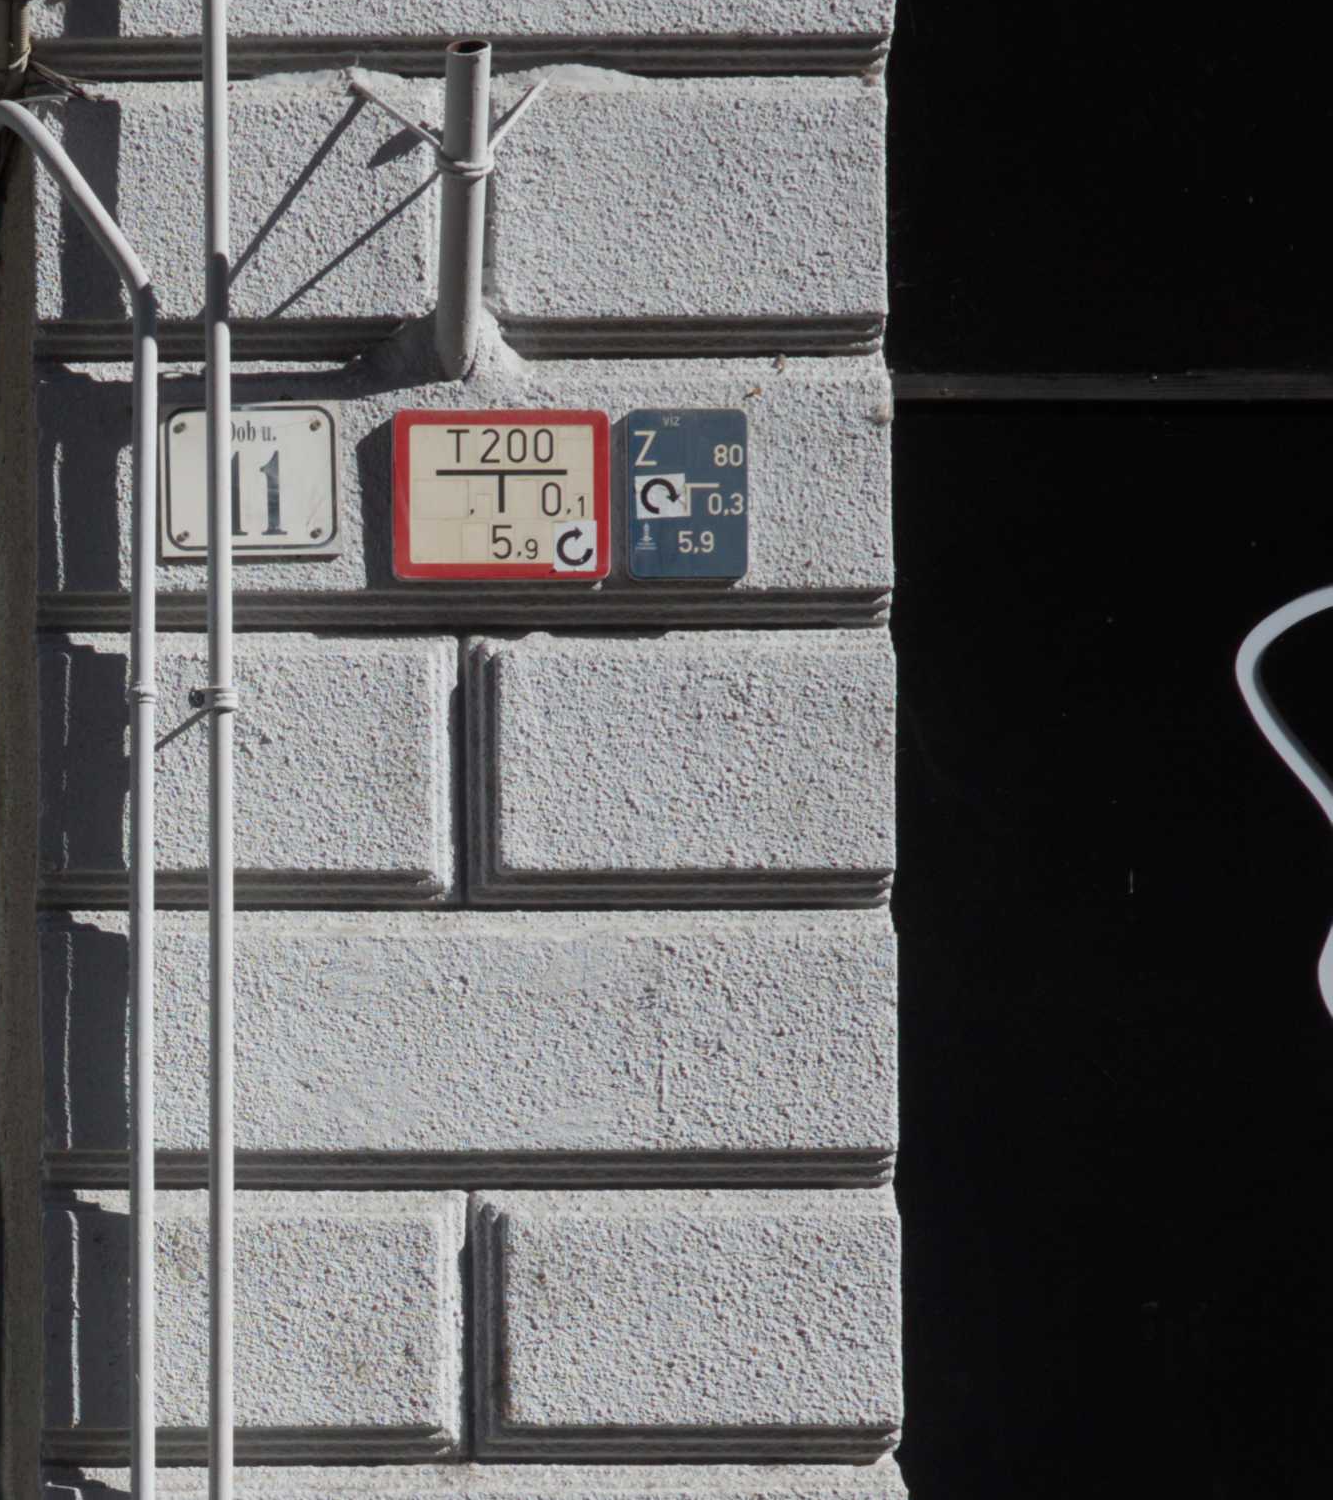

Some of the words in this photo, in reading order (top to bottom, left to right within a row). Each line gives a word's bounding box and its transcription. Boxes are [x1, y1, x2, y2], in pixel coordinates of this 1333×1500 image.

[231, 420, 256, 442] ob
[261, 427, 277, 442] u.
[634, 430, 658, 467] Z
[713, 443, 744, 467] 80
[231, 450, 288, 536] 11
[707, 492, 745, 517] 0,3
[491, 524, 539, 560] 5,9
[678, 530, 715, 554] 5,9
